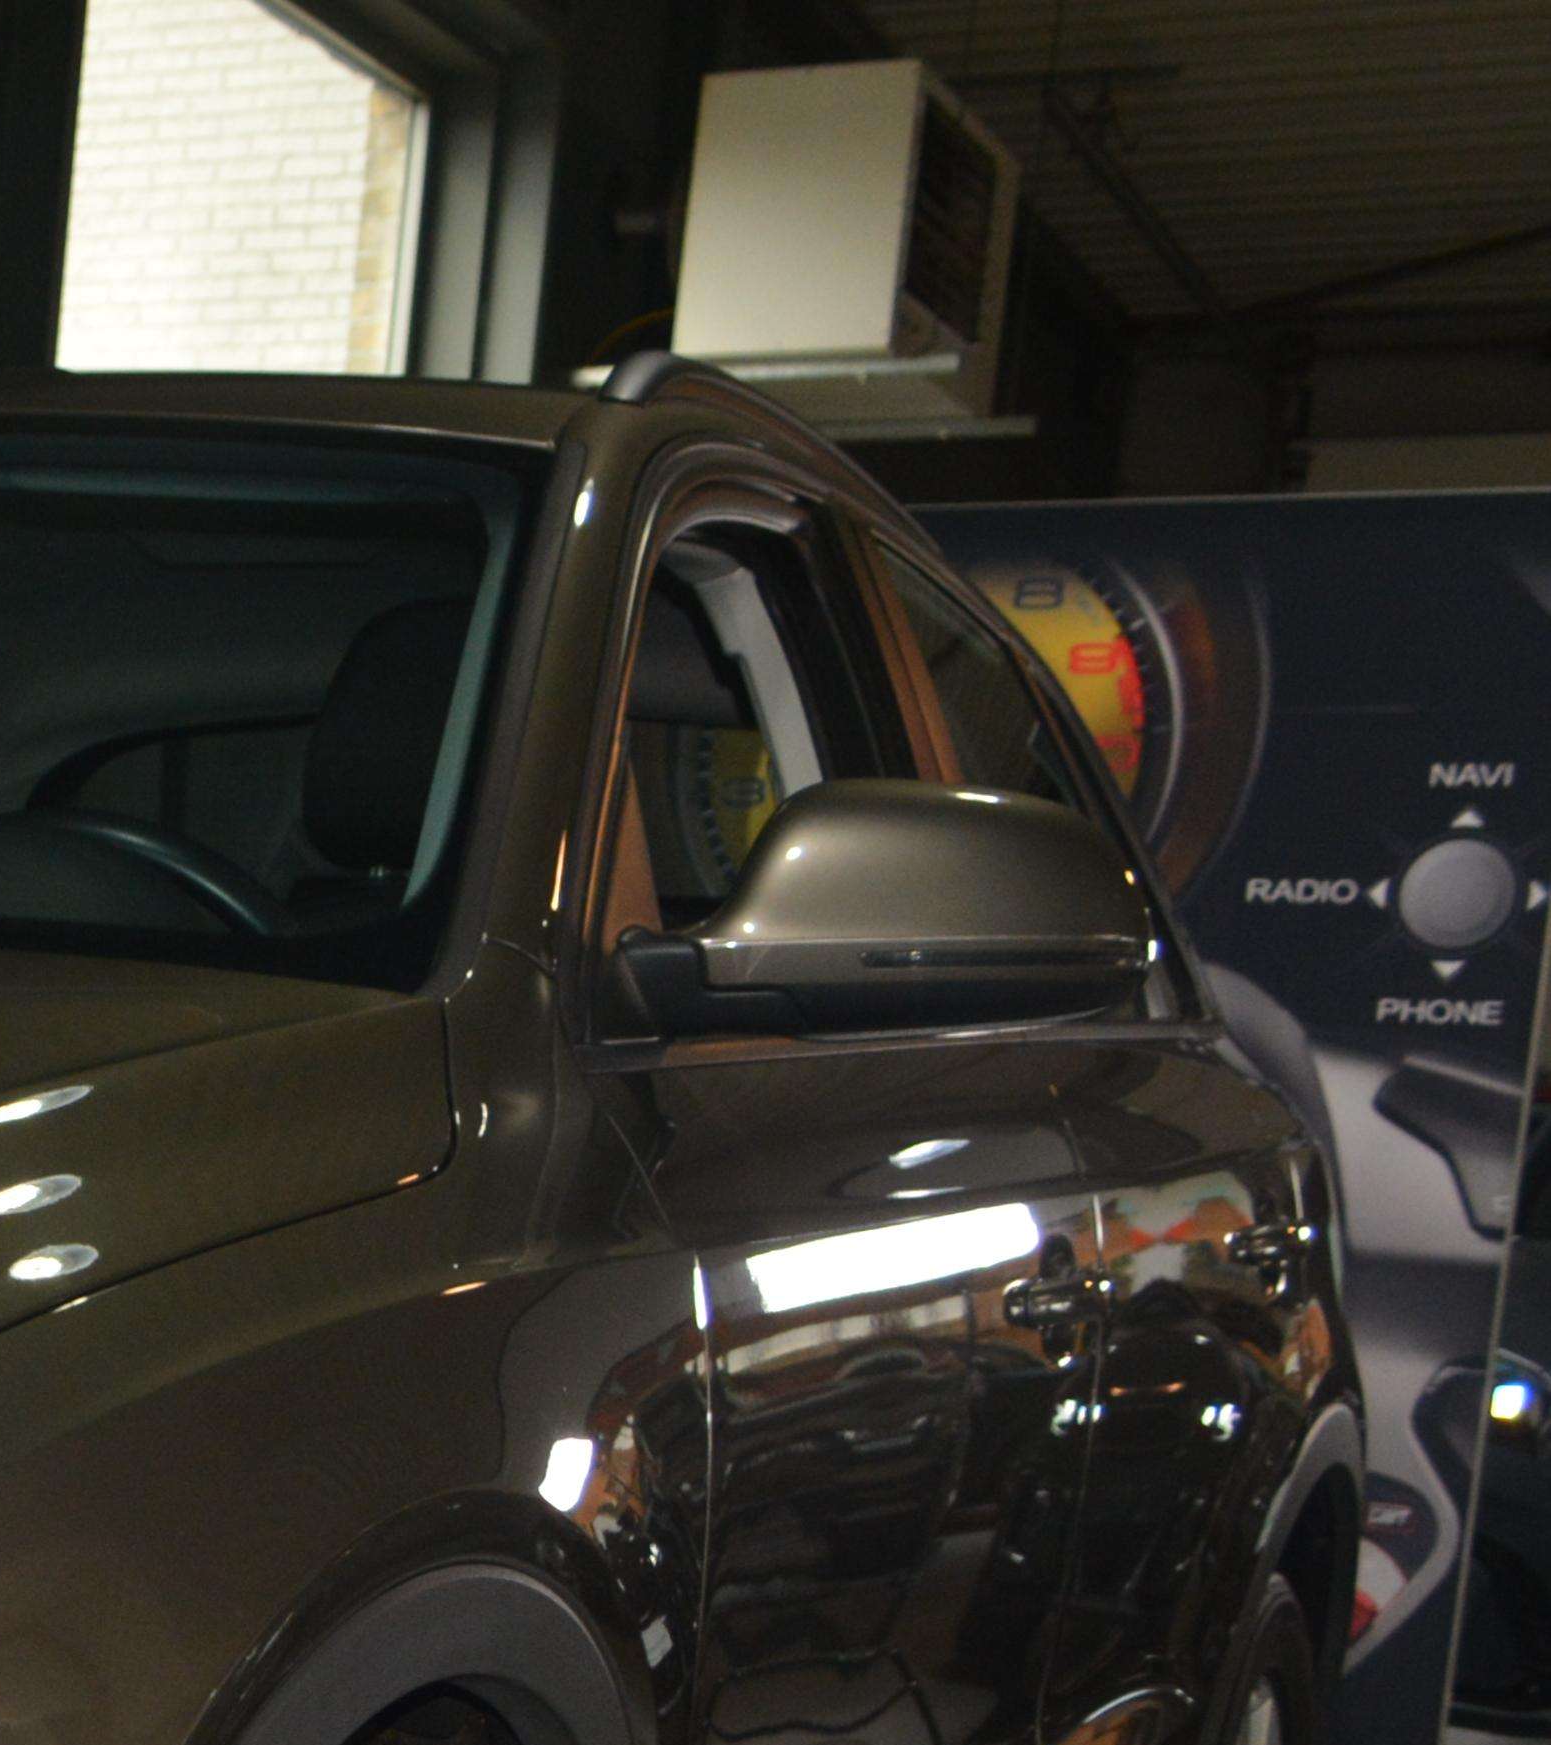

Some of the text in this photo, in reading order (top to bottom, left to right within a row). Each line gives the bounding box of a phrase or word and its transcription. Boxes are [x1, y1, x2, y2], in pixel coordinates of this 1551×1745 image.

[1428, 762, 1516, 787] NAVI
[1245, 877, 1359, 903] RADIO
[1375, 998, 1504, 1024] PHONE
